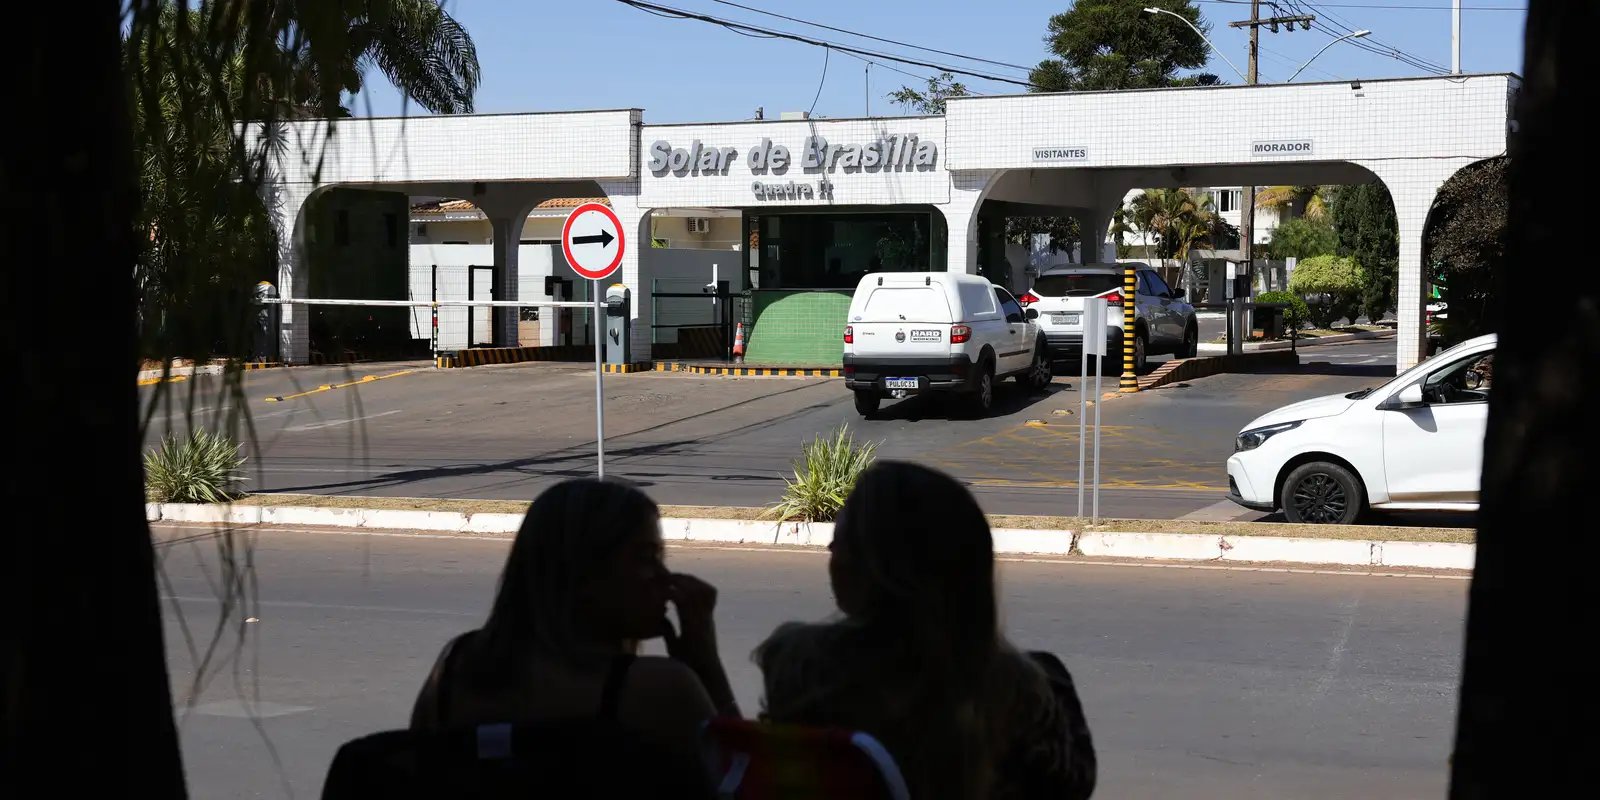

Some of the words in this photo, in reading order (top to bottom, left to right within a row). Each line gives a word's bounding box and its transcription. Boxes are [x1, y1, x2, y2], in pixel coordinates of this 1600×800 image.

[1035, 149, 1086, 158] VISITANTES
[1254, 143, 1310, 152] MORADOR
[649, 139, 738, 177] Solar
[747, 137, 791, 176] de
[800, 133, 938, 174] Brasília
[751, 180, 813, 200] Quadra
